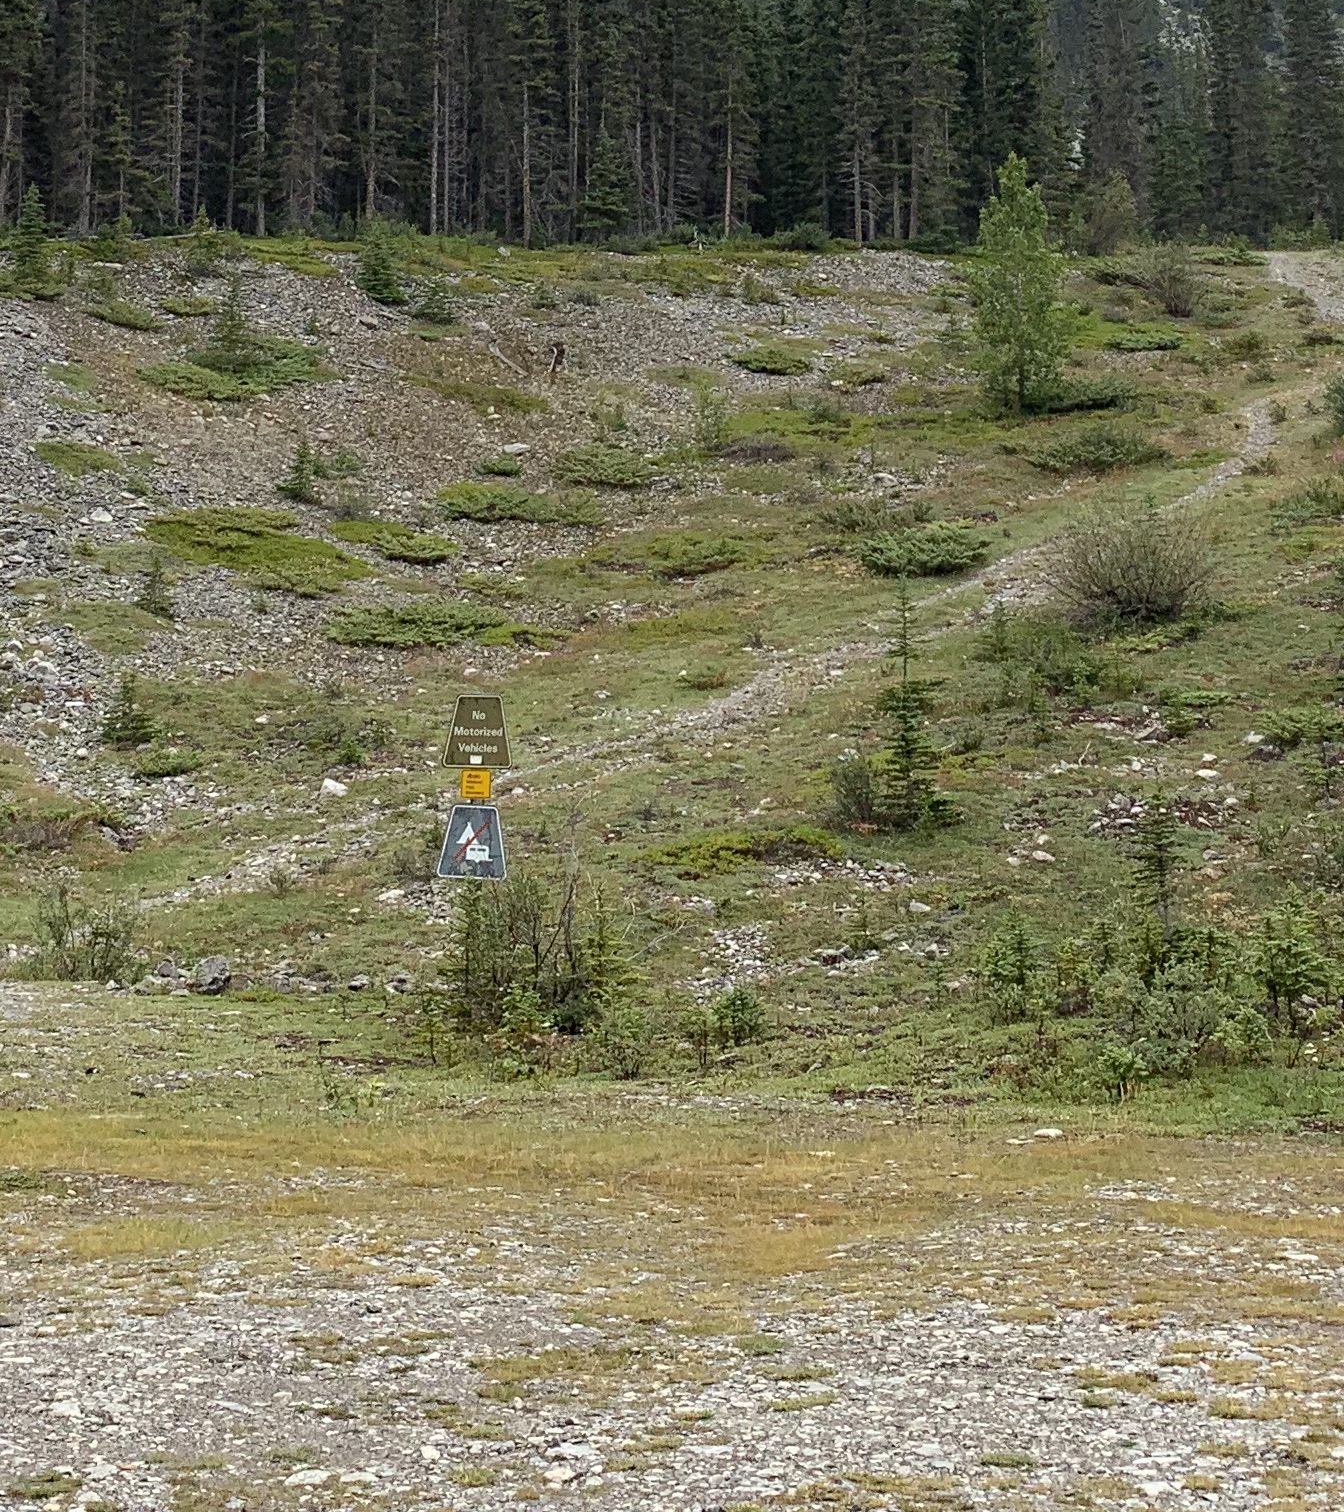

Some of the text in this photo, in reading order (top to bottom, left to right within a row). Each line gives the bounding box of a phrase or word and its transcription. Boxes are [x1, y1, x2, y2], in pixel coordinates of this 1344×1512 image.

[472, 710, 486, 720] No
[454, 727, 503, 737] Motorized
[458, 743, 498, 753] Vehicles
